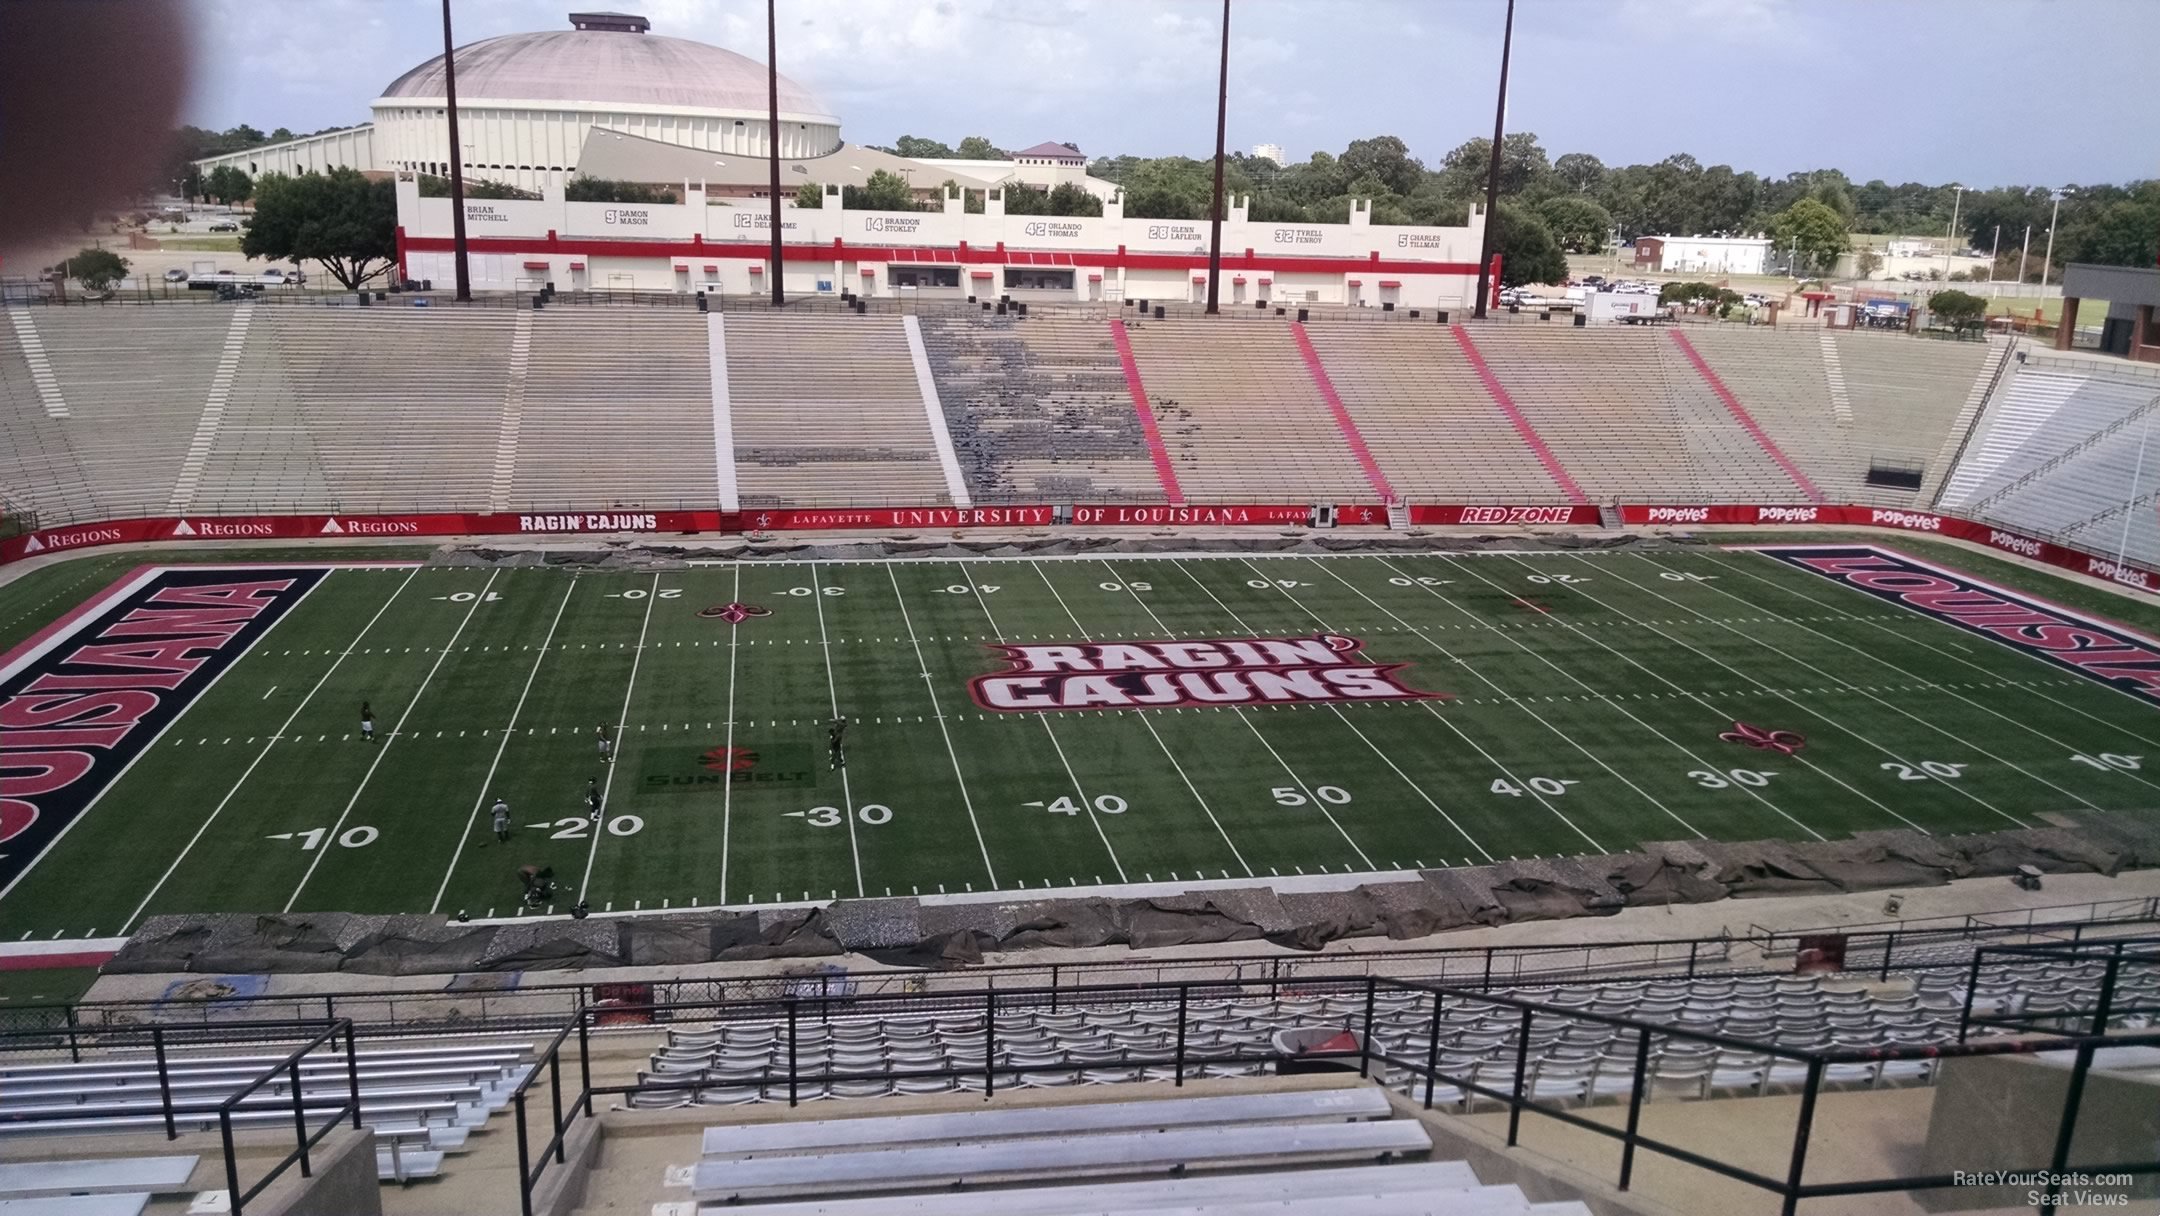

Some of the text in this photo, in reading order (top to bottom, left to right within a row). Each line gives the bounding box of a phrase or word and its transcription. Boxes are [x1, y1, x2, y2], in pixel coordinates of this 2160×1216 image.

[734, 213, 752, 228] 12
[866, 218, 883, 231] 14
[1025, 223, 1046, 236] 42
[1149, 226, 1169, 239] 28
[1275, 230, 1294, 243] 32
[1399, 234, 1408, 247] 5
[586, 515, 657, 529] CAJUNS
[793, 514, 872, 524] LAFAYETTE
[893, 508, 1249, 525] UNIVERSITY OF LOUISIANA
[1460, 507, 1573, 524] RED ZONE
[200, 522, 272, 535] REGIONS
[348, 520, 418, 533] REGIONS
[48, 528, 121, 549] REGIONS
[981, 667, 1413, 708] CAJUNS
